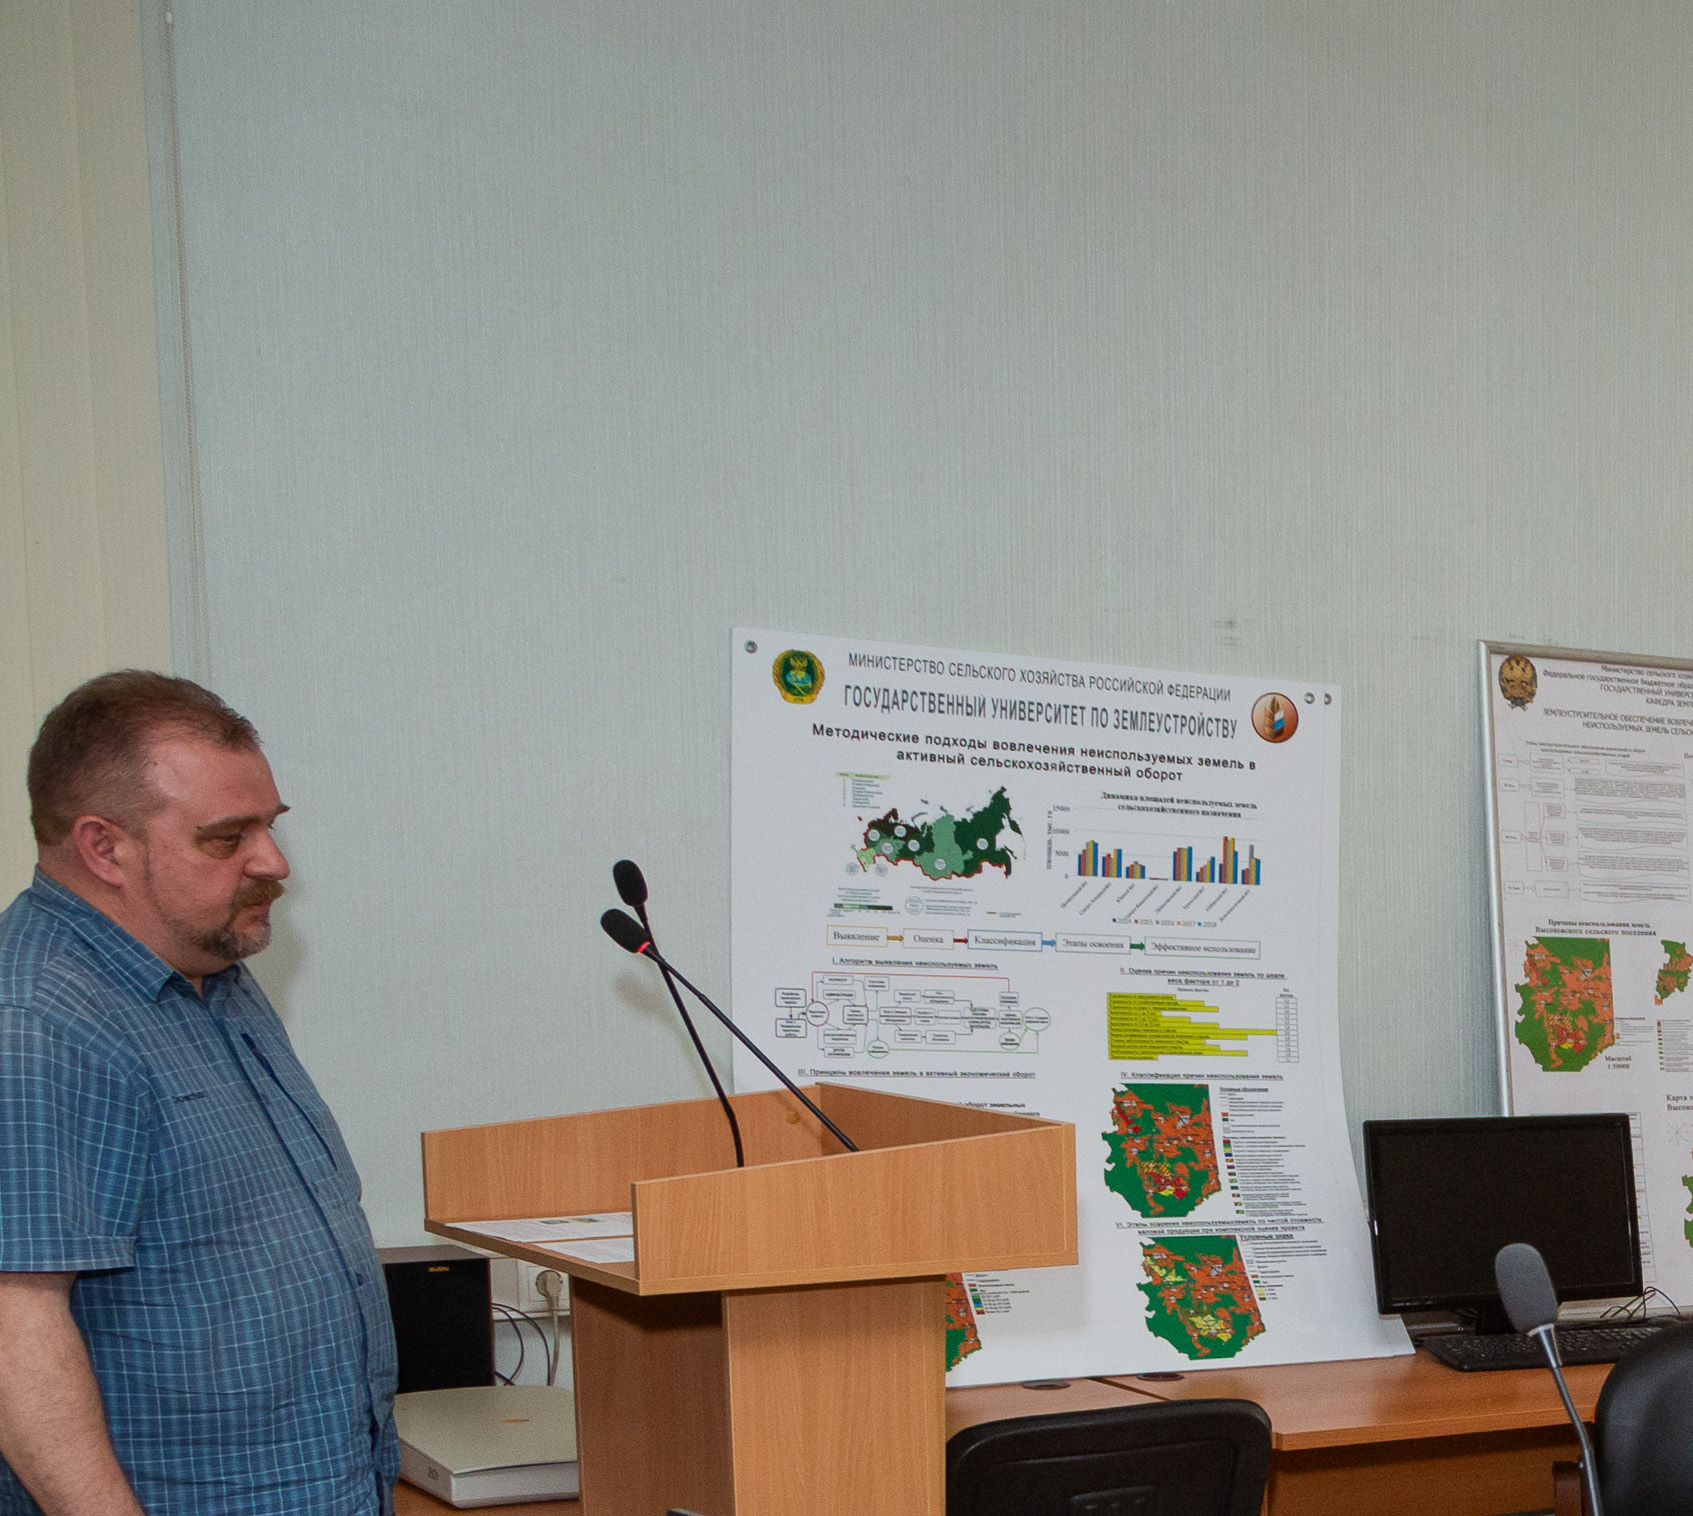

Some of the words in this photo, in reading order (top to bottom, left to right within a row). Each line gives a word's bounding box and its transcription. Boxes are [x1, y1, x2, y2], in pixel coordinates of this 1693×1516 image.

[848, 652, 945, 675] МИНИСТЕРСТВО
[949, 662, 1016, 682] СЕЛЬСКОГО
[1019, 668, 1086, 689] ХОЗЯЙСТВА
[1089, 676, 1164, 696] РОССИЙСКОЙ
[1167, 683, 1232, 703] ФЕДЕРАЦИИ
[1600, 684, 1664, 697] ГОСУДАРСТВЕННЫЙ
[1645, 697, 1675, 707] КАФЕДРА
[844, 684, 987, 719] ГОСУДАРСТВЕННЫЙ
[991, 697, 1086, 727] УНИВЕРСИТЕТ
[1090, 706, 1109, 729] ПО
[1113, 708, 1238, 740] ЗЕМЛЕУСТРОЙСТВУ
[1543, 707, 1619, 722] ЗЕМЛЕУСТРОИТЕЛЬНОЕ
[812, 722, 920, 744] Методические
[925, 735, 987, 751] подходы
[992, 740, 1076, 757] вовлечения
[1080, 746, 1194, 766] неиспользуемых
[1197, 756, 1245, 770] земель
[1249, 761, 1256, 771] в
[896, 749, 966, 766] активный
[970, 755, 1132, 779] сельскохозяйственный
[1136, 768, 1183, 783] оборот
[832, 931, 881, 943] Выявление
[912, 933, 945, 945] Оценка
[973, 934, 1037, 948] Классификация
[1062, 938, 1087, 949] Этапы
[1088, 940, 1125, 950] освоения
[1666, 1094, 1688, 1103] Карта
